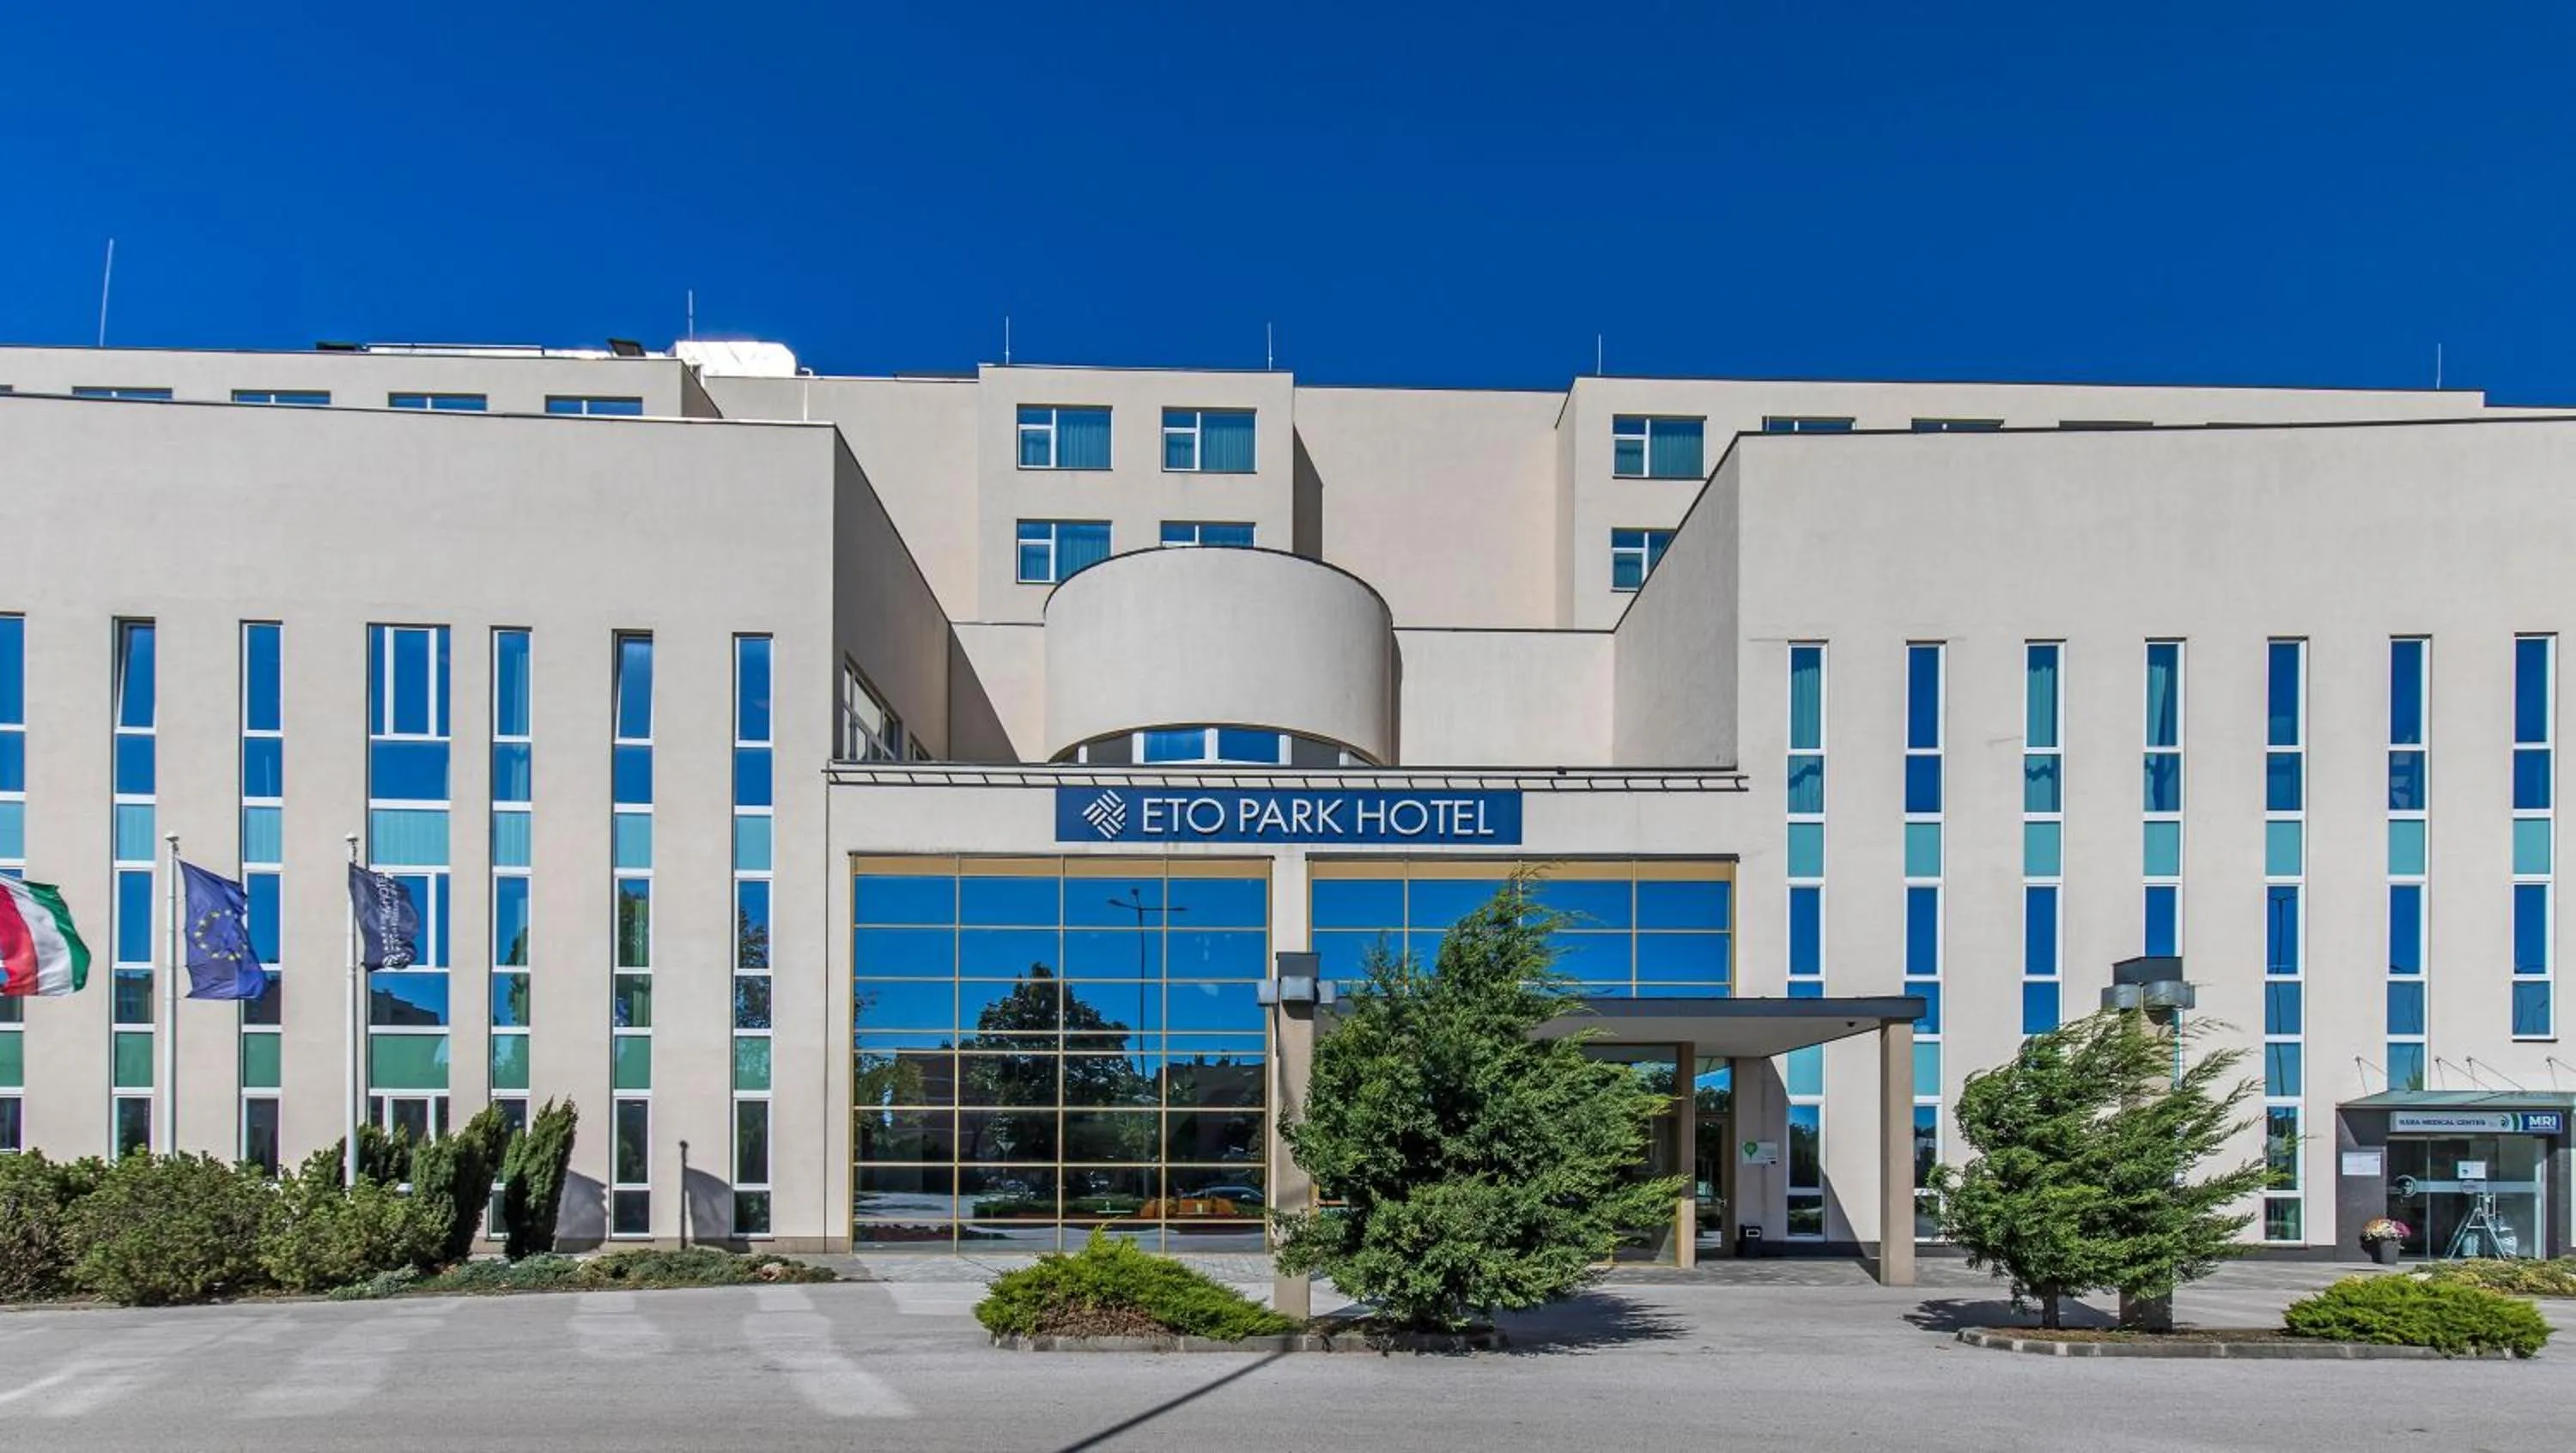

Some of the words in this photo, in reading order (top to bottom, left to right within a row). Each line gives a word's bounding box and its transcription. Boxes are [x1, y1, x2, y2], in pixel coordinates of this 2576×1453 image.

[1143, 798, 1225, 833] ETO
[1239, 798, 1343, 834] PARK
[1358, 799, 1494, 835] HOTEL
[2529, 1116, 2556, 1127] MRI
